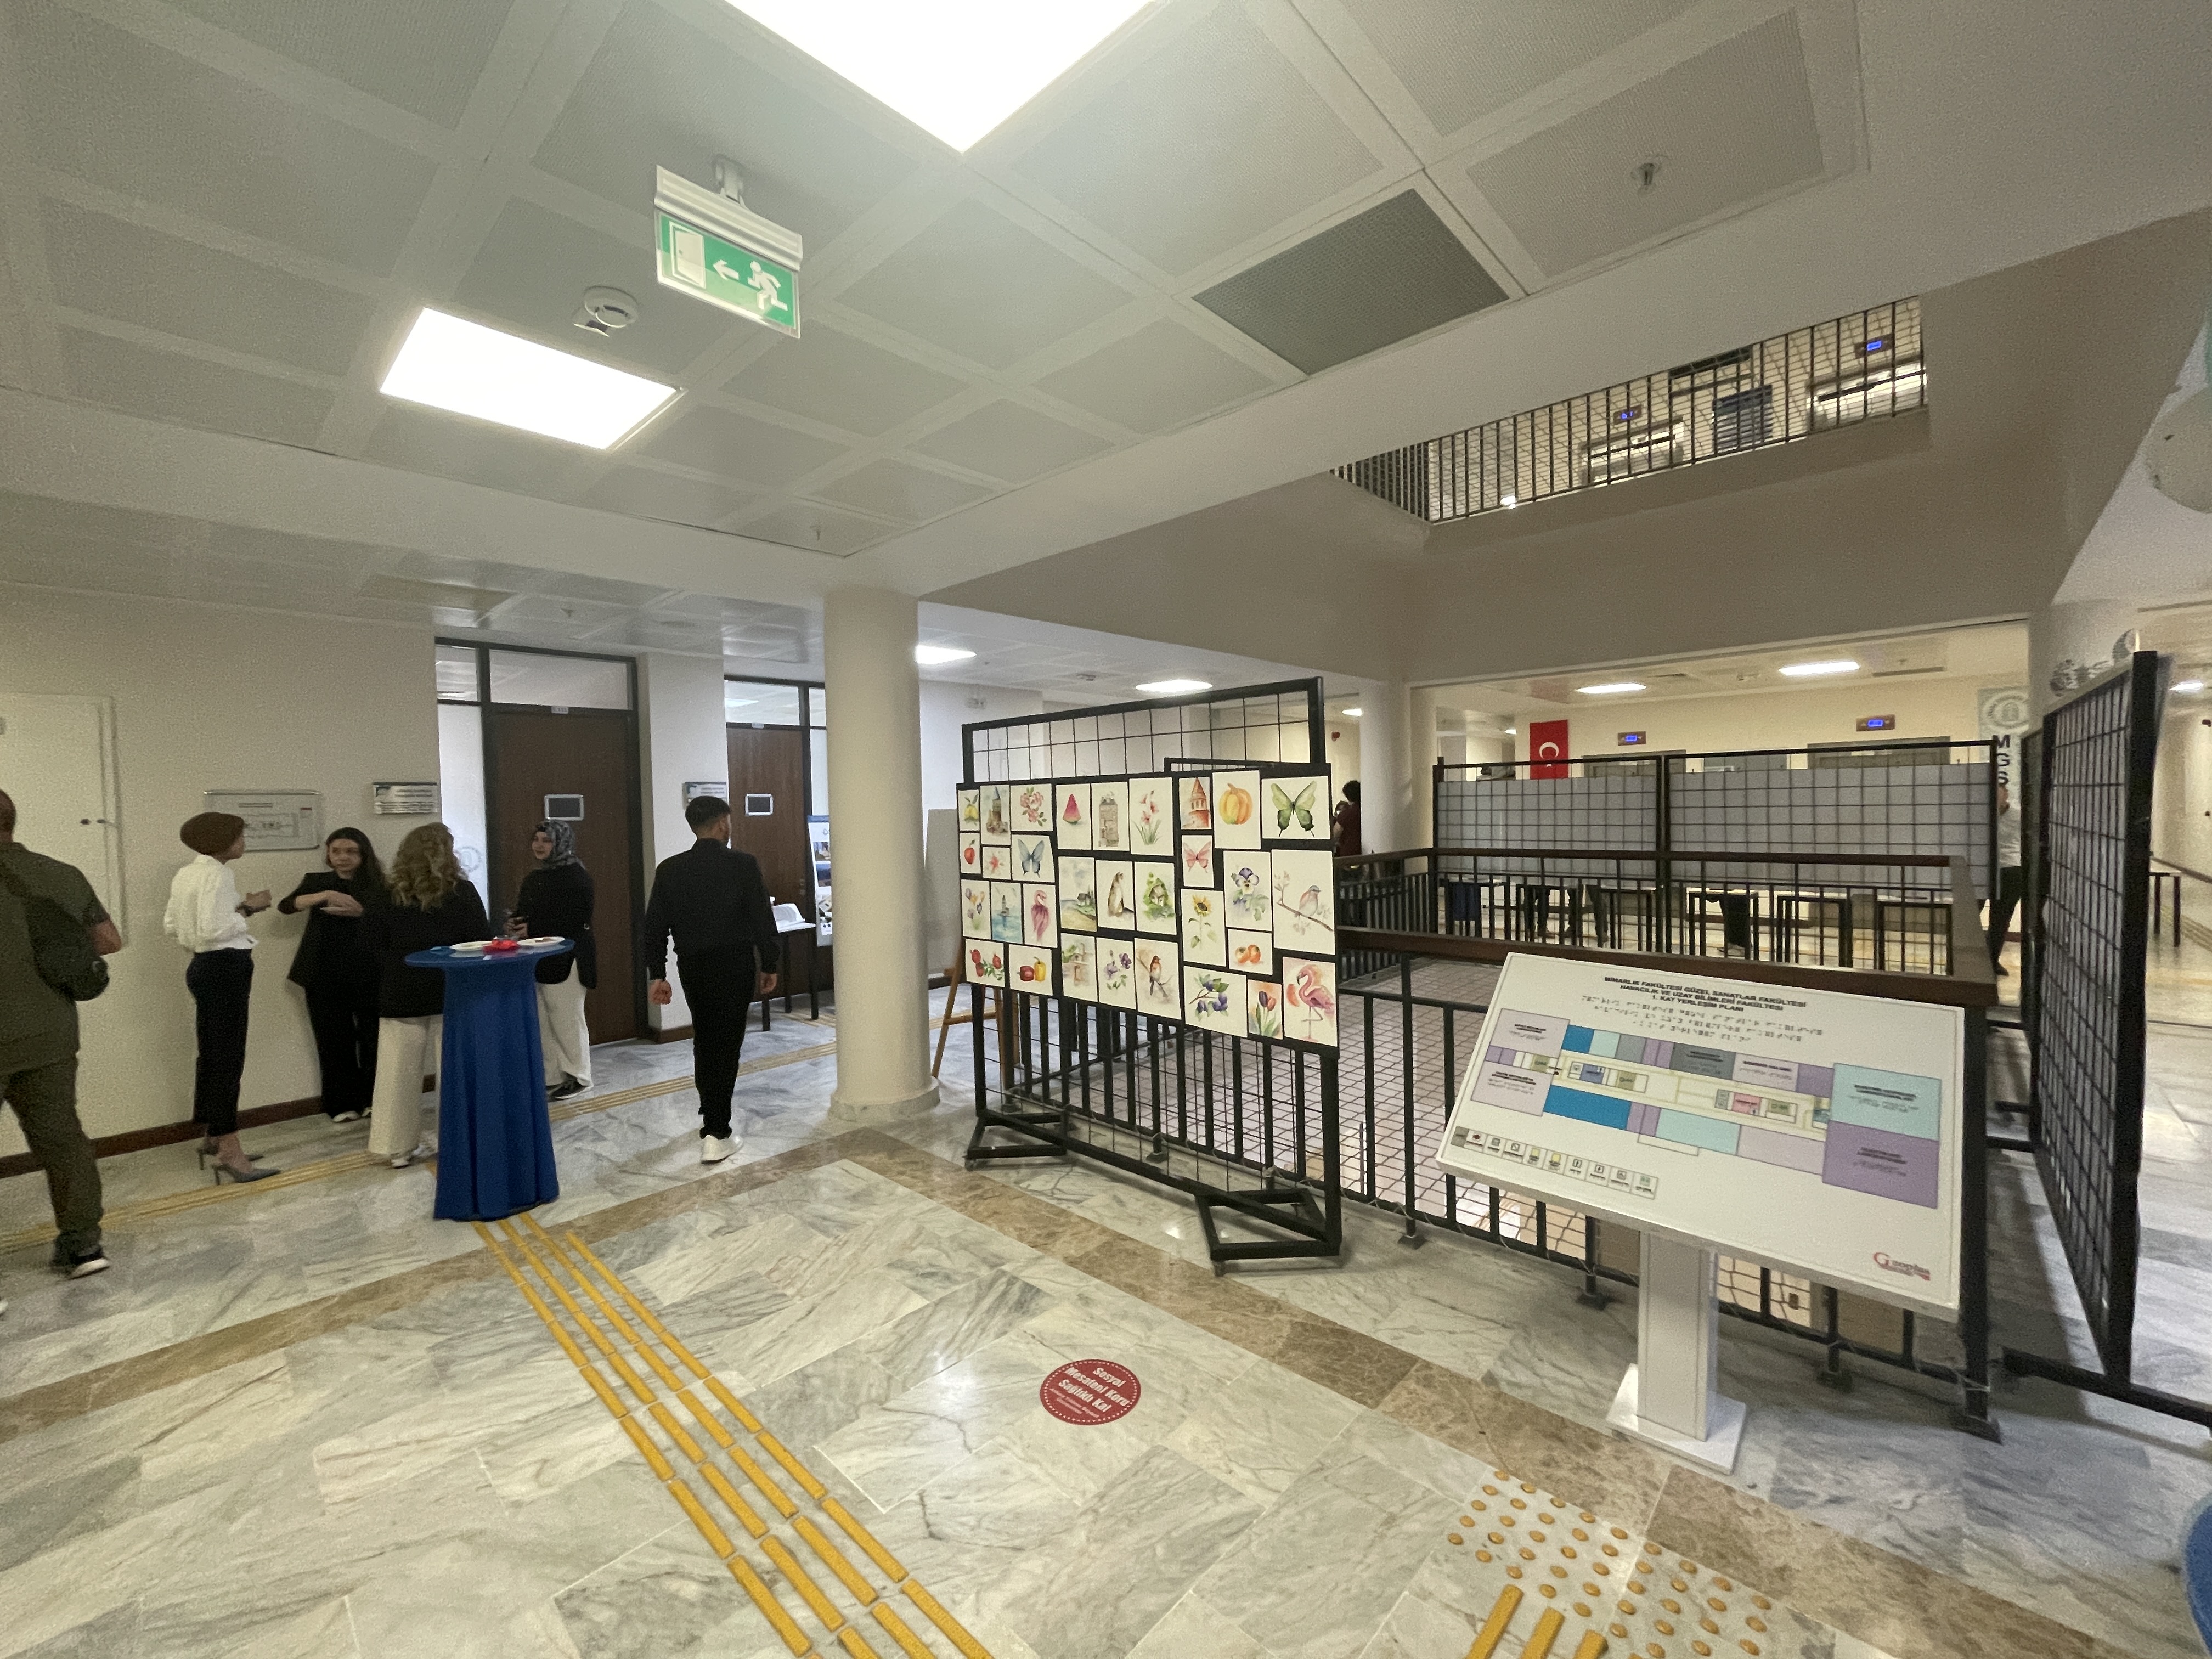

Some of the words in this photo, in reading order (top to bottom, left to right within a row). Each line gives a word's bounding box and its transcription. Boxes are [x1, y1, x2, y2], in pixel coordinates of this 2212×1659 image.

[1093, 1367, 1126, 1387] Sosyal
[1092, 1398, 1112, 1412] Kal
[1104, 1389, 1130, 1407] Koru
